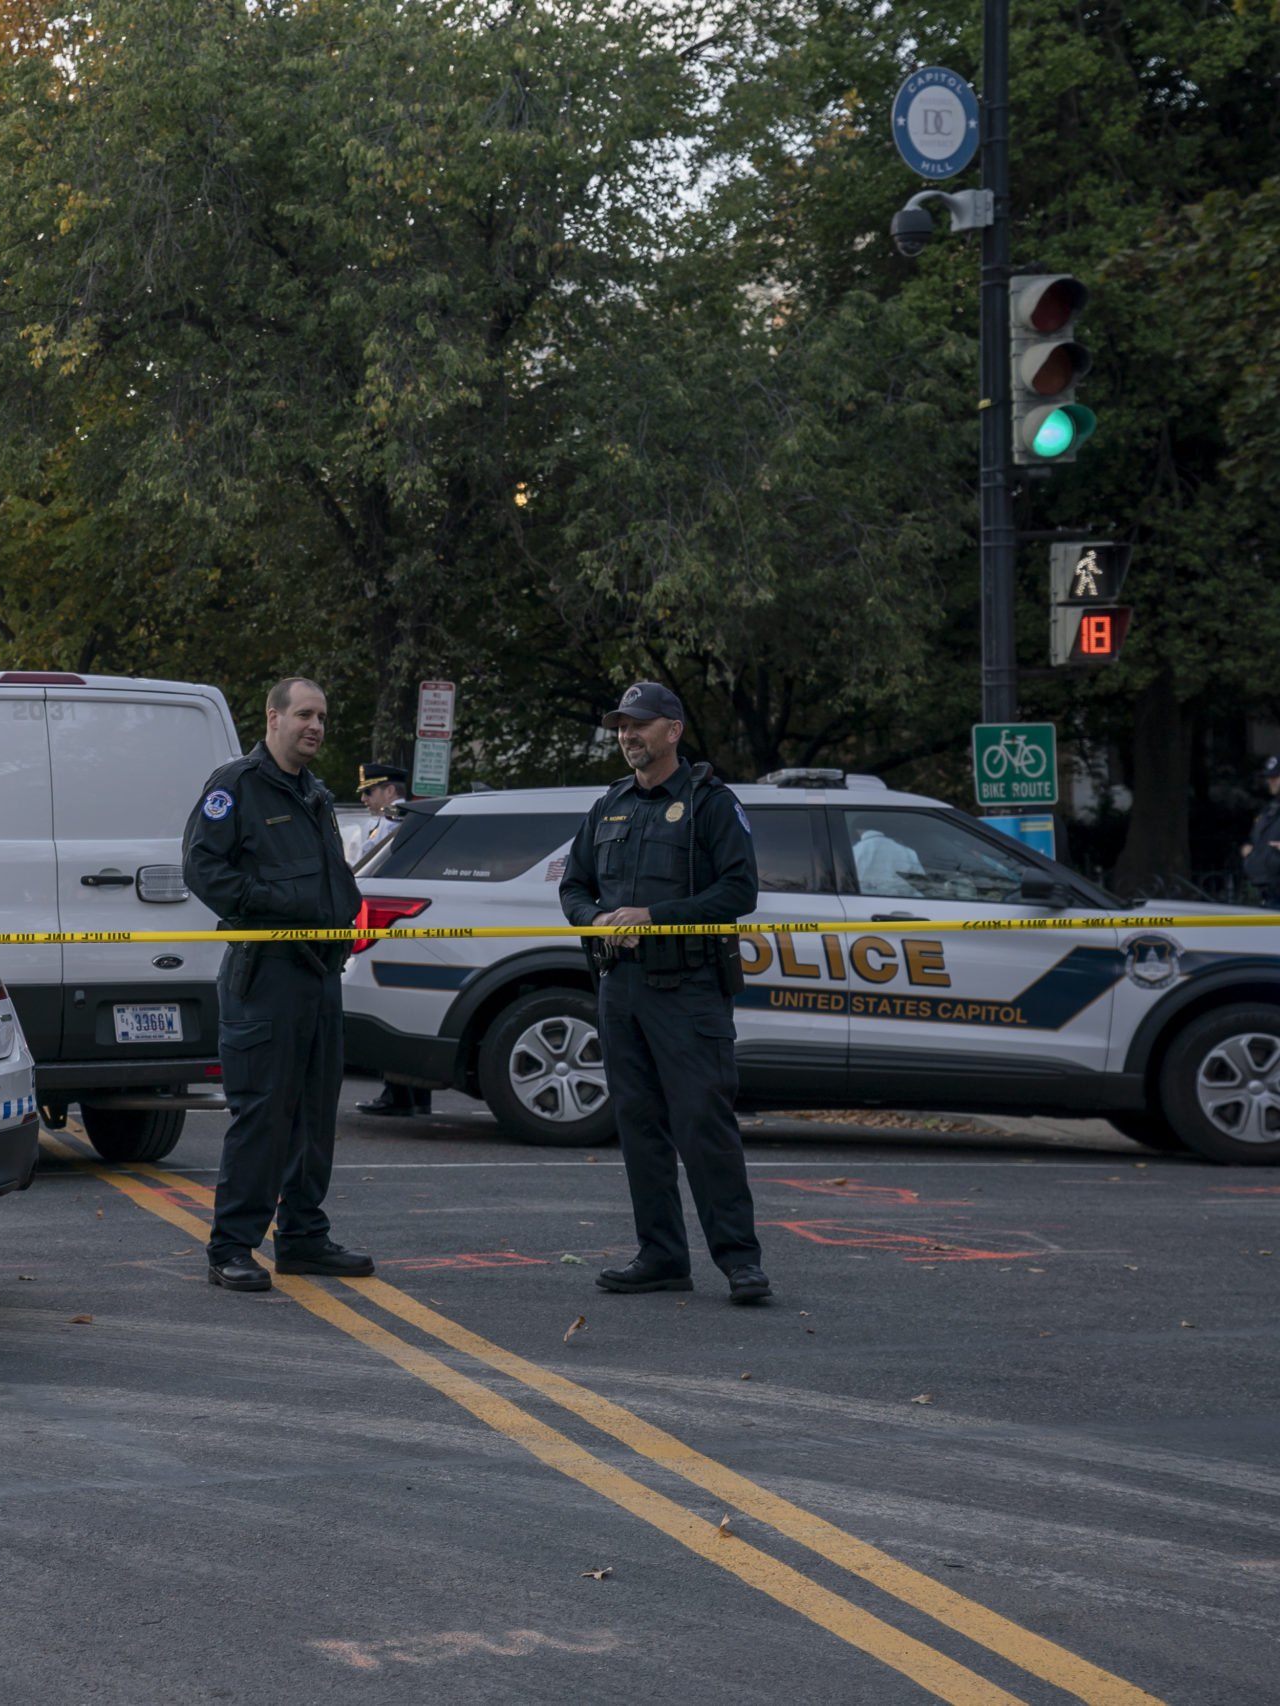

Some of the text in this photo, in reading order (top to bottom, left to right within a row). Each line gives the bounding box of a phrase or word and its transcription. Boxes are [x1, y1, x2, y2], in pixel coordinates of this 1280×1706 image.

[907, 72, 963, 95] CAPITOL
[922, 108, 953, 136] DC
[920, 160, 953, 174] HILL
[1081, 615, 1111, 654] 18
[12, 702, 76, 721] 2031
[981, 780, 1052, 798] BIKE ROUTE
[442, 868, 458, 876] Join
[473, 869, 491, 877] team
[738, 932, 952, 988] OLICE
[770, 990, 1028, 1024] UNITED STATES CAPITOL
[135, 1013, 174, 1032] 3366W
